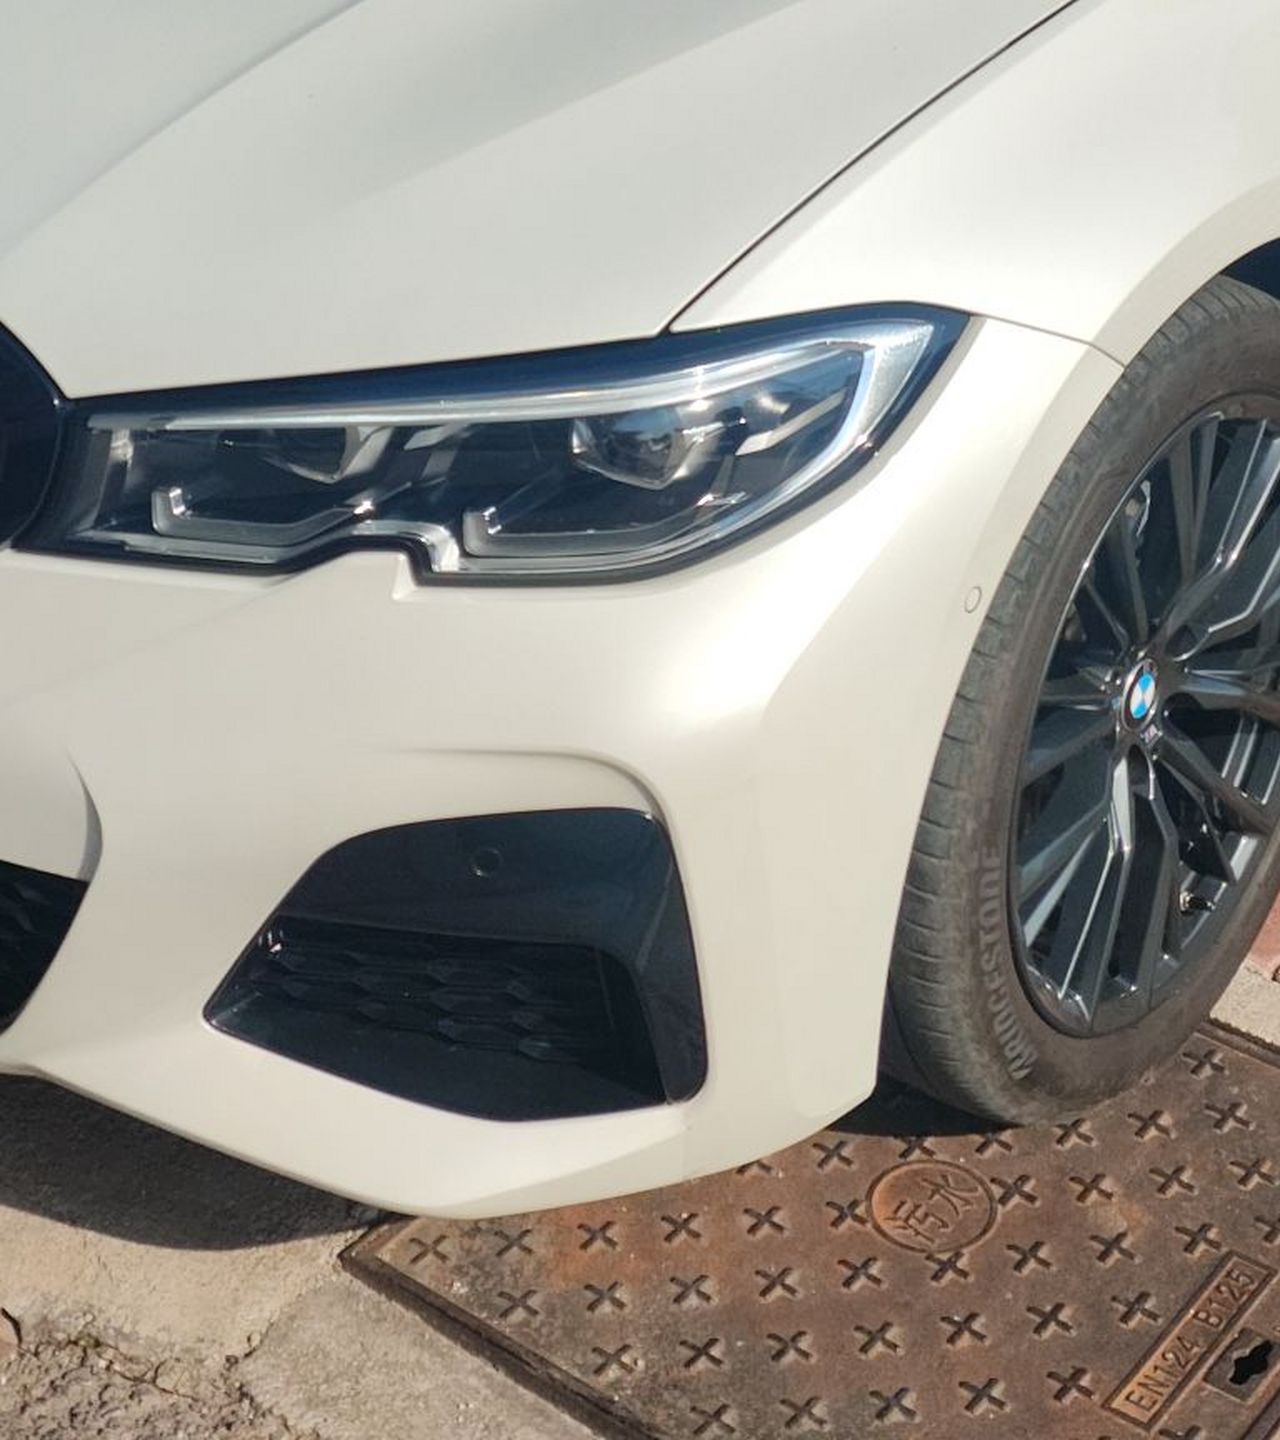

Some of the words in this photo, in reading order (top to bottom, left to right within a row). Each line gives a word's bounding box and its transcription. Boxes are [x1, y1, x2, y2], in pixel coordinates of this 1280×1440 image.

[884, 1175, 978, 1243] 污水
[1126, 1337, 1195, 1411] EN124
[1193, 1268, 1257, 1329] B125
